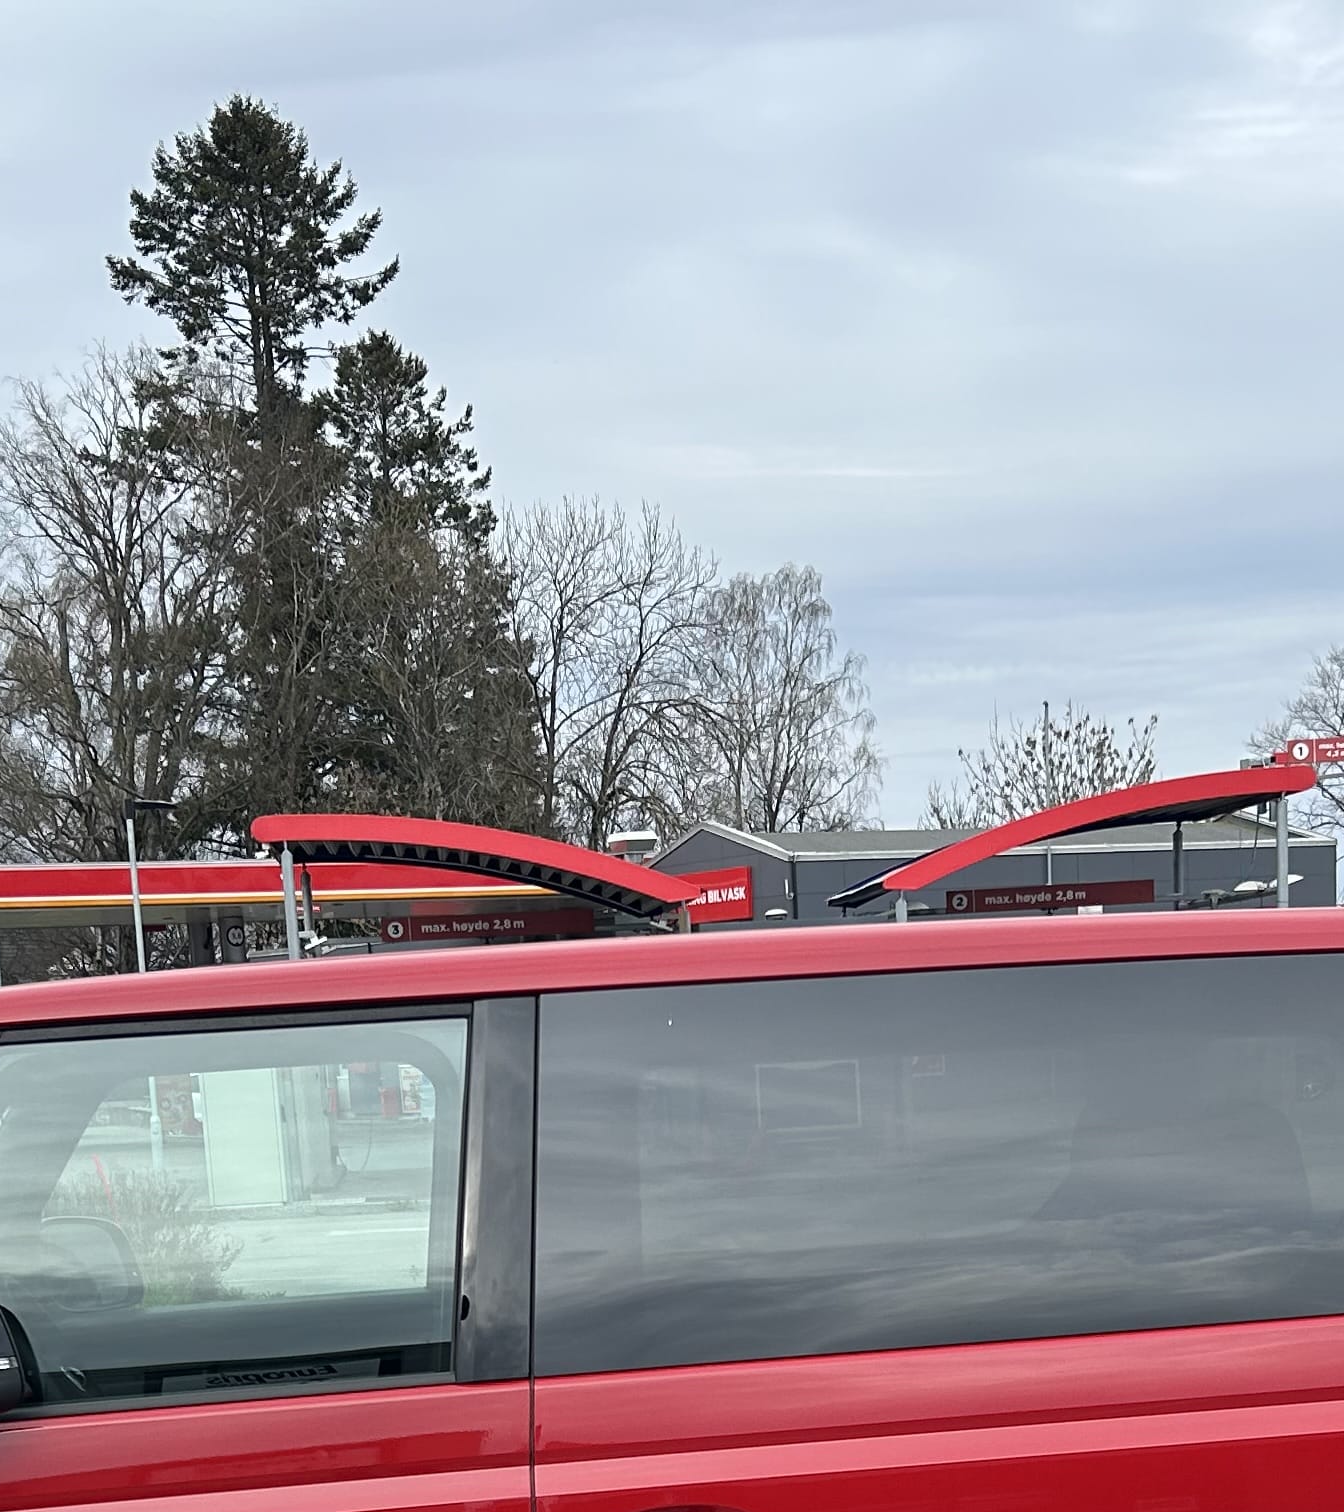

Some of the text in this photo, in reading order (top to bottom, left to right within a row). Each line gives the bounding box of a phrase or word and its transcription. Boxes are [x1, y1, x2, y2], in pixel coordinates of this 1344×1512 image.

[707, 886, 746, 904] BILVASK
[985, 895, 1013, 905] max.
[1016, 891, 1052, 904] høyde
[421, 923, 450, 934] max.
[453, 920, 490, 933] høyde
